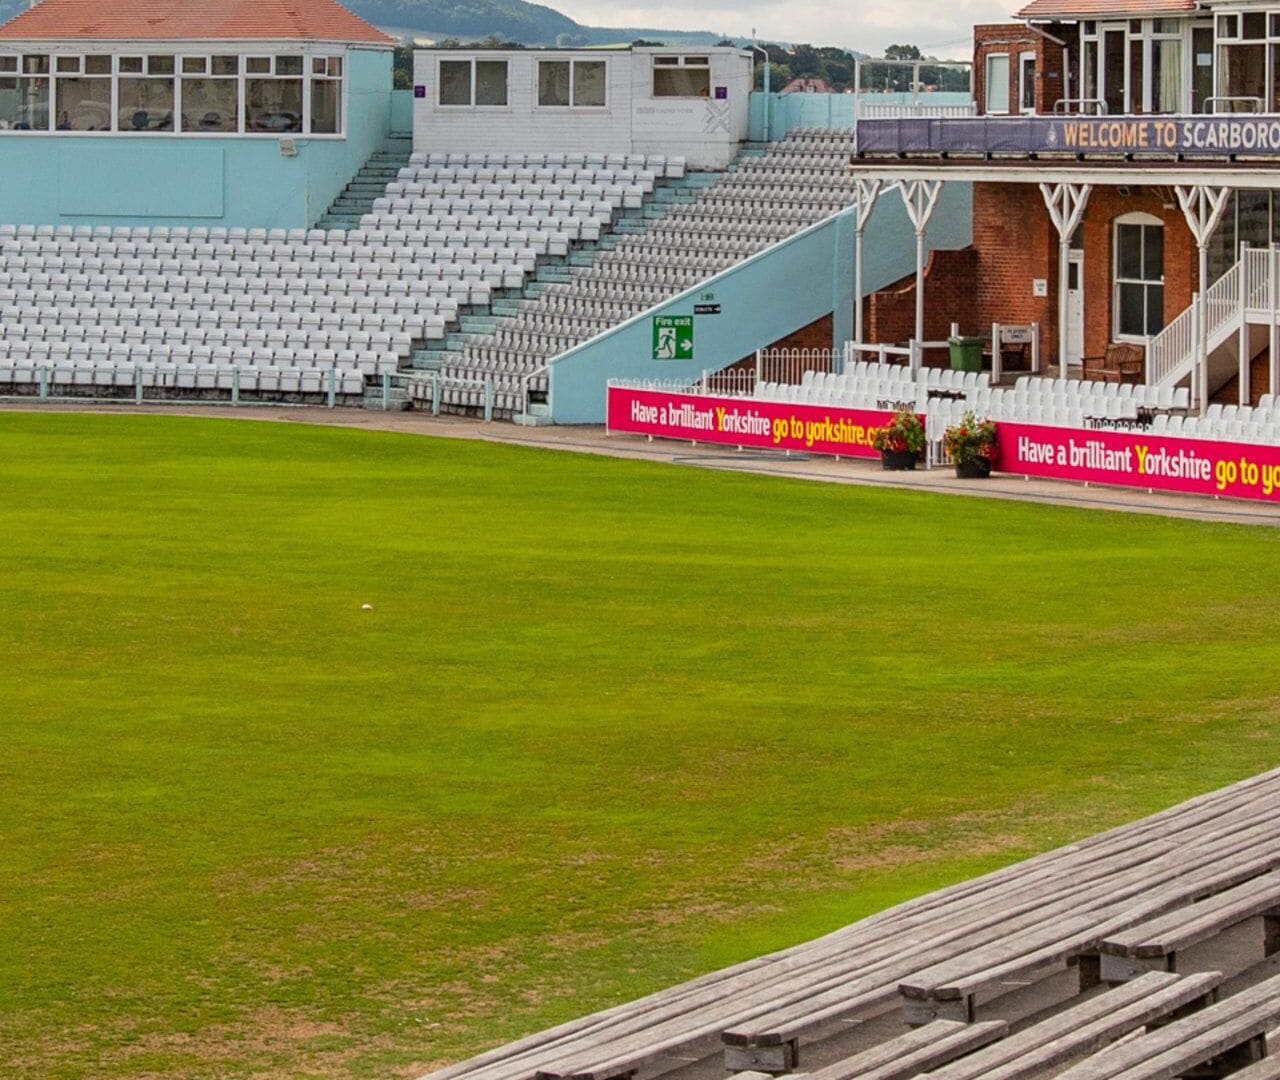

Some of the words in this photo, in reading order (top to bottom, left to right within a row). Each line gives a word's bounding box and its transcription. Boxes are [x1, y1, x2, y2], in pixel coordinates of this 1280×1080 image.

[1064, 122, 1148, 147] WELCOME
[1154, 122, 1177, 147] TO
[655, 317, 672, 326] Fire
[674, 317, 690, 326] exit
[631, 400, 658, 424] Have
[660, 407, 667, 425] a
[669, 402, 714, 430] brilliant
[716, 407, 770, 436] Yorkshire
[773, 419, 788, 443] go
[790, 417, 803, 439] to
[1018, 436, 1055, 465] Have
[1057, 444, 1066, 466] a
[1070, 439, 1132, 473] brilliant
[1135, 445, 1211, 480] Yorkshire
[1215, 460, 1236, 489] go
[1240, 457, 1258, 483] to
